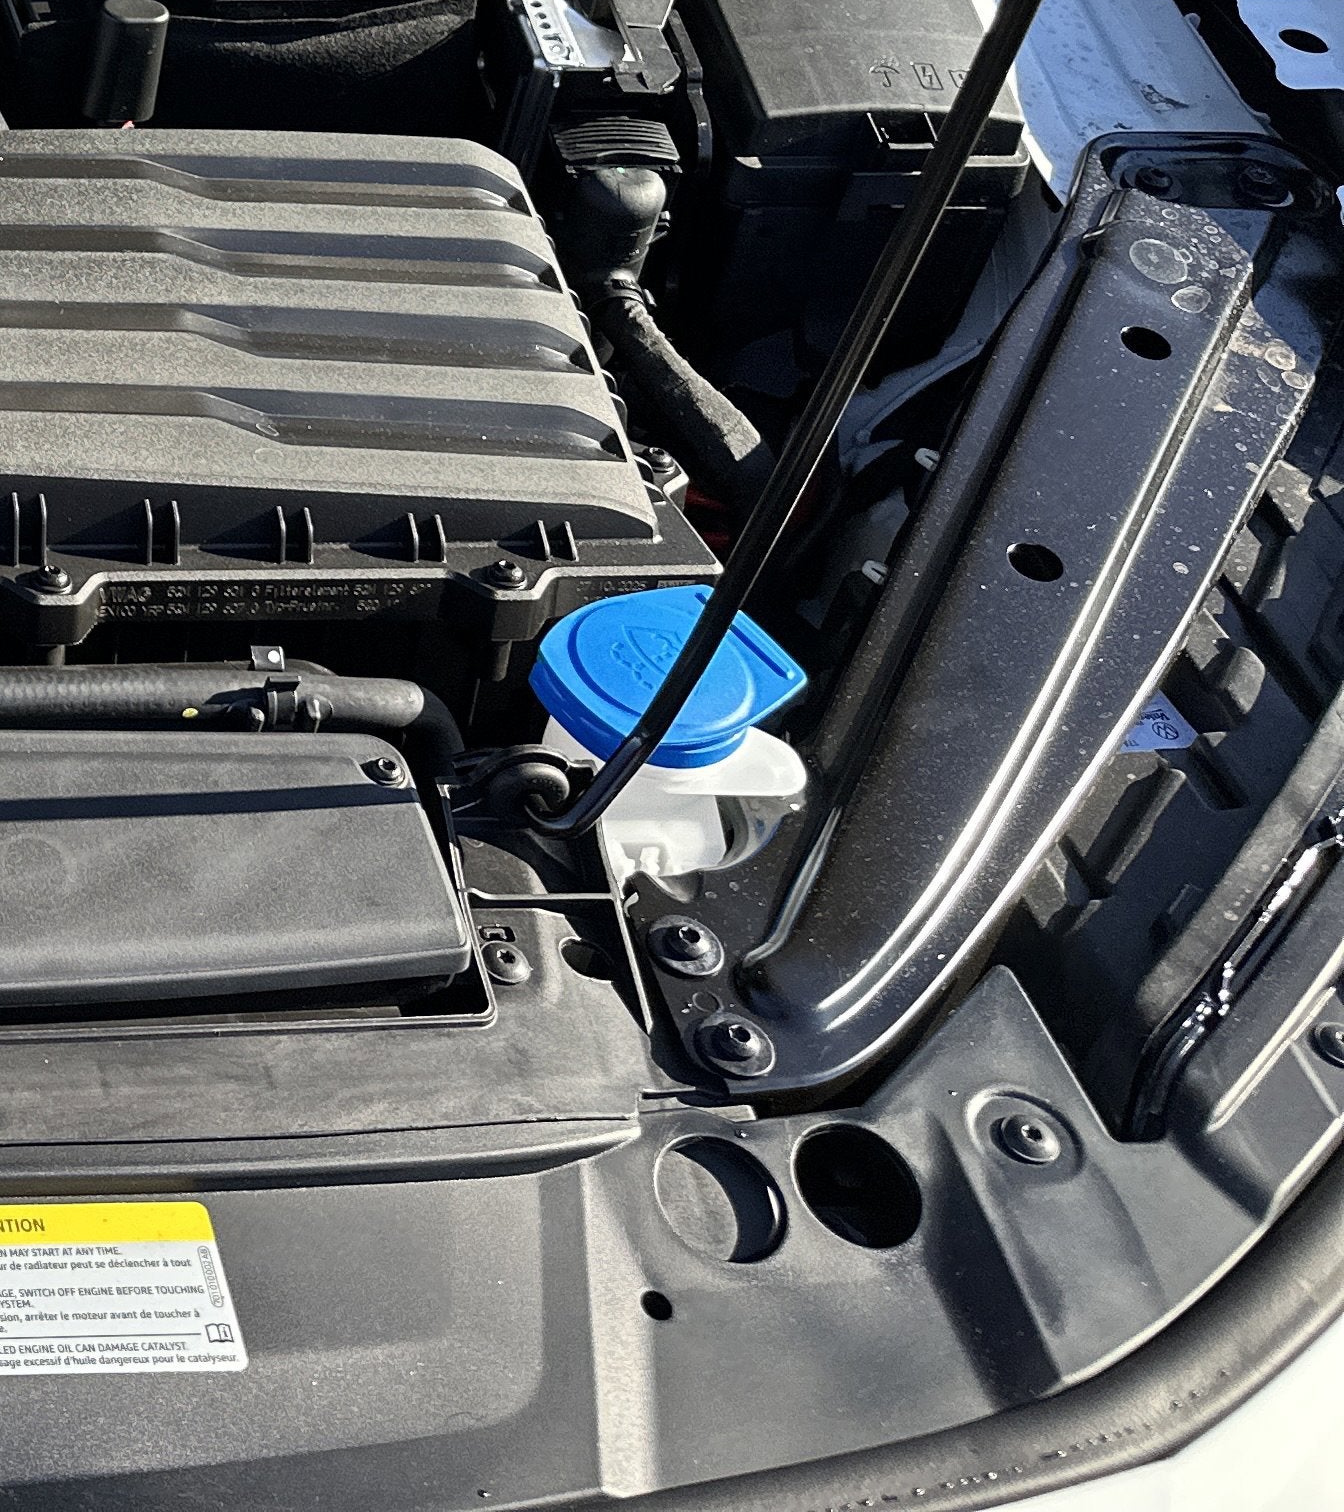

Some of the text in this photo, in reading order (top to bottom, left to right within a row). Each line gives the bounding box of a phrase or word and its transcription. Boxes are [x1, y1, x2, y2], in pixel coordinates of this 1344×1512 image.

[10, 1249, 29, 1257] MAY
[32, 1248, 59, 1257] START
[62, 1248, 73, 1256] AT
[76, 1247, 94, 1256] ANY
[9, 1261, 21, 1270] de
[24, 1260, 67, 1270] radiateur
[71, 1260, 93, 1271] peut
[163, 1258, 169, 1267] à
[171, 1258, 191, 1266] tout
[19, 1288, 55, 1297] SWITCH
[58, 1288, 76, 1296] OFF
[79, 1287, 114, 1296] ENGINE
[116, 1286, 154, 1295] BEFORE
[156, 1286, 205, 1294] TOUCHING
[25, 1312, 58, 1321] arrêter
[61, 1312, 69, 1320] le
[72, 1311, 107, 1320] moteur
[110, 1311, 137, 1319] avant
[140, 1310, 151, 1319] de
[154, 1309, 191, 1318] toucher
[194, 1309, 200, 1317] à
[19, 1345, 55, 1354] ENGINE
[57, 1345, 73, 1353] OIL
[76, 1343, 95, 1352] CAN
[99, 1343, 139, 1351] DAMAGE
[23, 1356, 62, 1366] excessif
[99, 1356, 149, 1366] dangereux
[152, 1356, 173, 1365] pour
[176, 1354, 185, 1363] le
